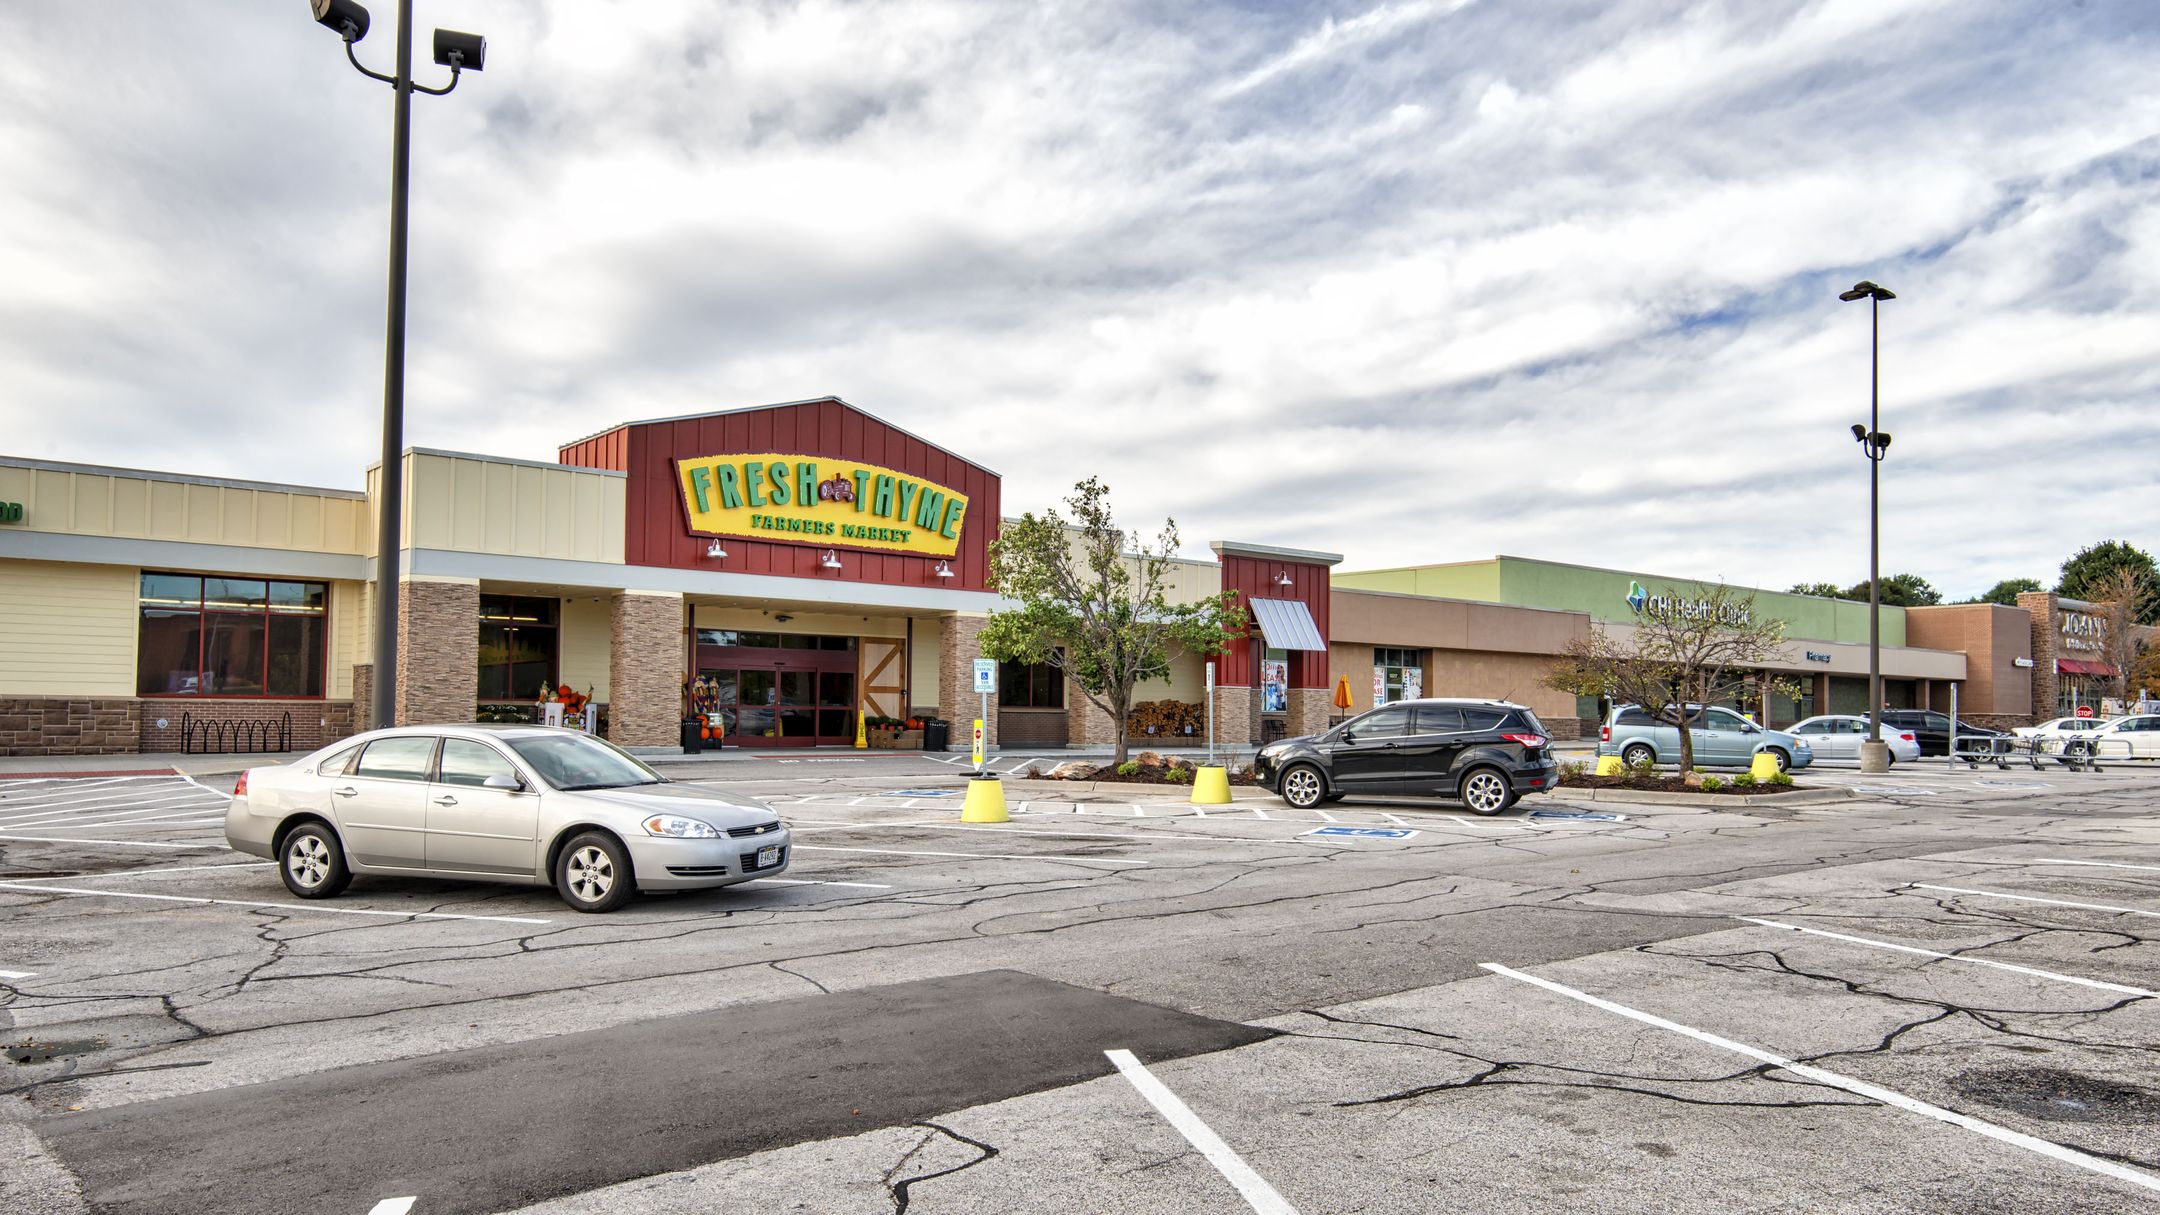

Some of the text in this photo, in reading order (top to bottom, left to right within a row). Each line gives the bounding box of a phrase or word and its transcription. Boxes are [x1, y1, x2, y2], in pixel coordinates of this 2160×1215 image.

[691, 461, 964, 540] FRESH THYME
[752, 514, 912, 543] FARMERS MARKET
